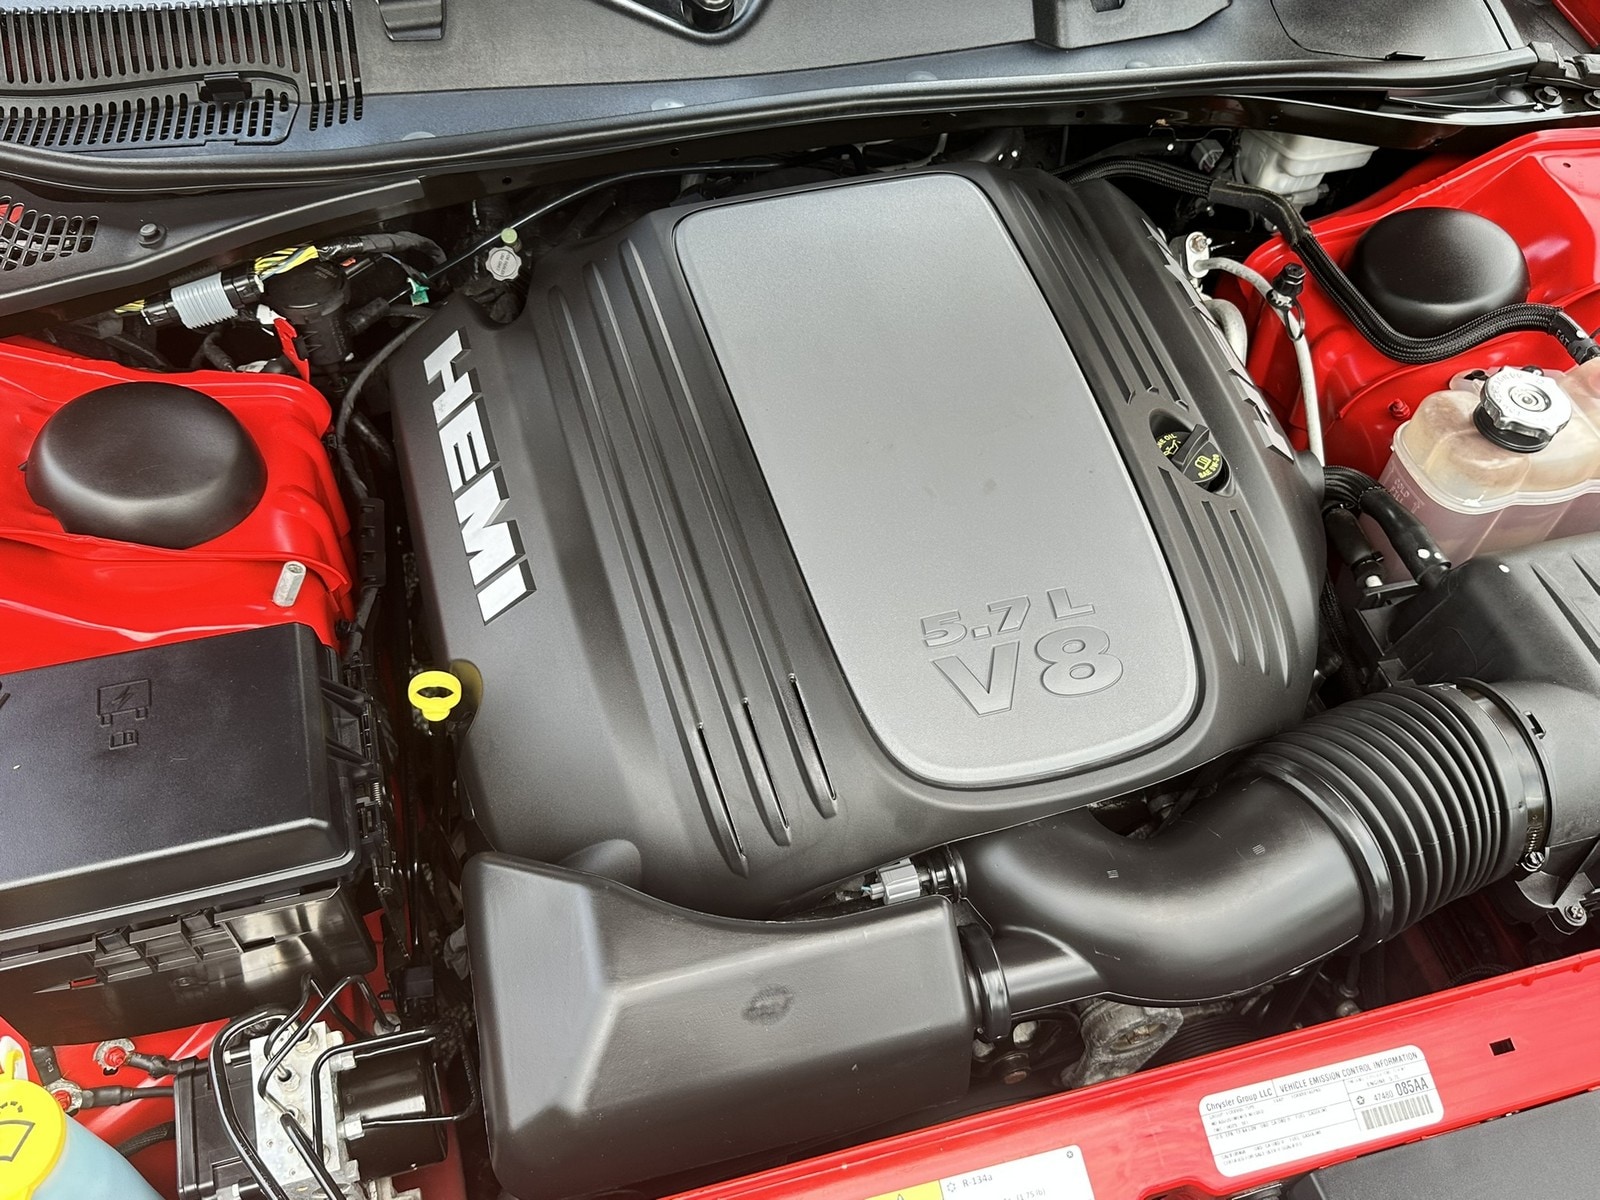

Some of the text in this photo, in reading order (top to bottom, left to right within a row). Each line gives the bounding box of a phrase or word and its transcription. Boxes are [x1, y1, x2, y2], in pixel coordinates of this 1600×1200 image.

[1163, 433, 1177, 441] OIL
[423, 328, 534, 625] HEMI
[1393, 478, 1410, 498] COLD
[930, 624, 1124, 718] V8
[1279, 1078, 1307, 1093] VEHICLE
[1309, 1071, 1341, 1086] EMISSION
[1341, 1063, 1371, 1077] CONTROL
[1373, 1052, 1418, 1069] INFORMATION
[1394, 1076, 1429, 1096] 085AA
[1205, 1098, 1235, 1111] Chrysler
[1236, 1091, 1258, 1104] Group
[1259, 1087, 1273, 1098] LLC
[962, 1173, 993, 1188] R-134a
